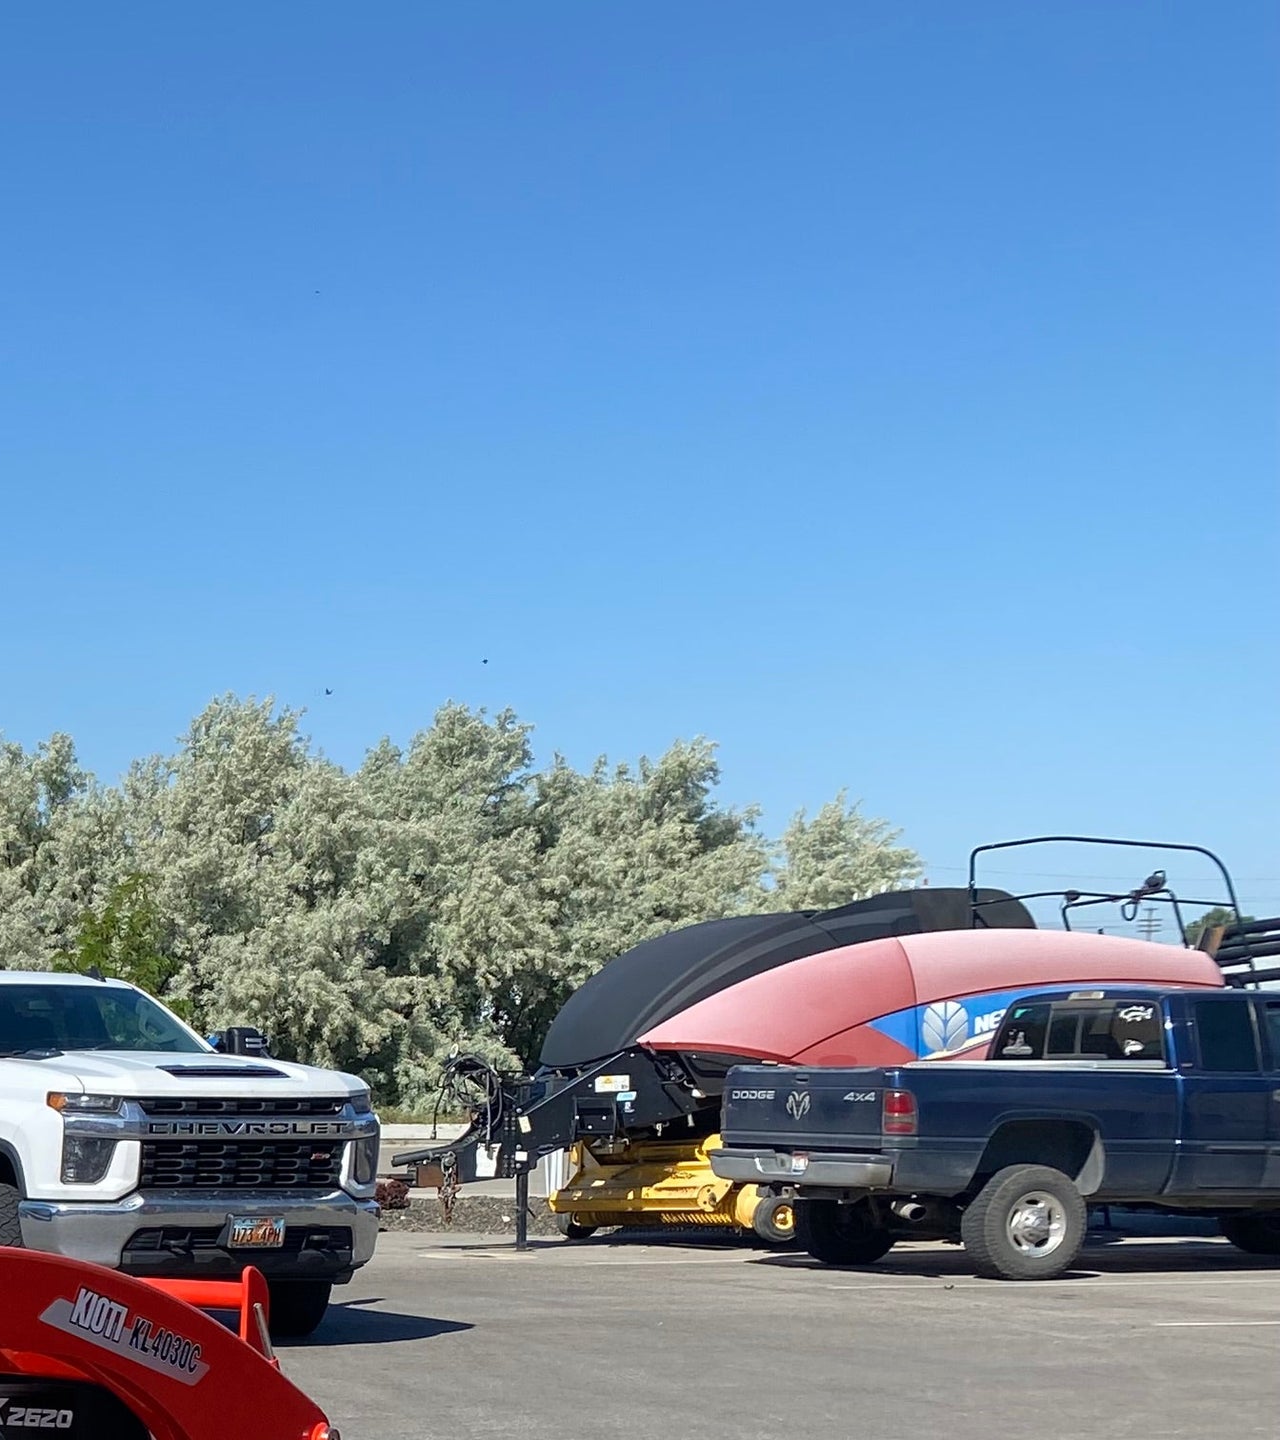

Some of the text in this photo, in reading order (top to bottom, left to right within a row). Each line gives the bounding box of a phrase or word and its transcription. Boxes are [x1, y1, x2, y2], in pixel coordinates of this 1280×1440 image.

[974, 1008, 1007, 1035] NE
[732, 1090, 775, 1100] DODGE
[148, 1122, 348, 1135] CHEVROLET
[70, 1287, 202, 1374] KIOTI KL4030C
